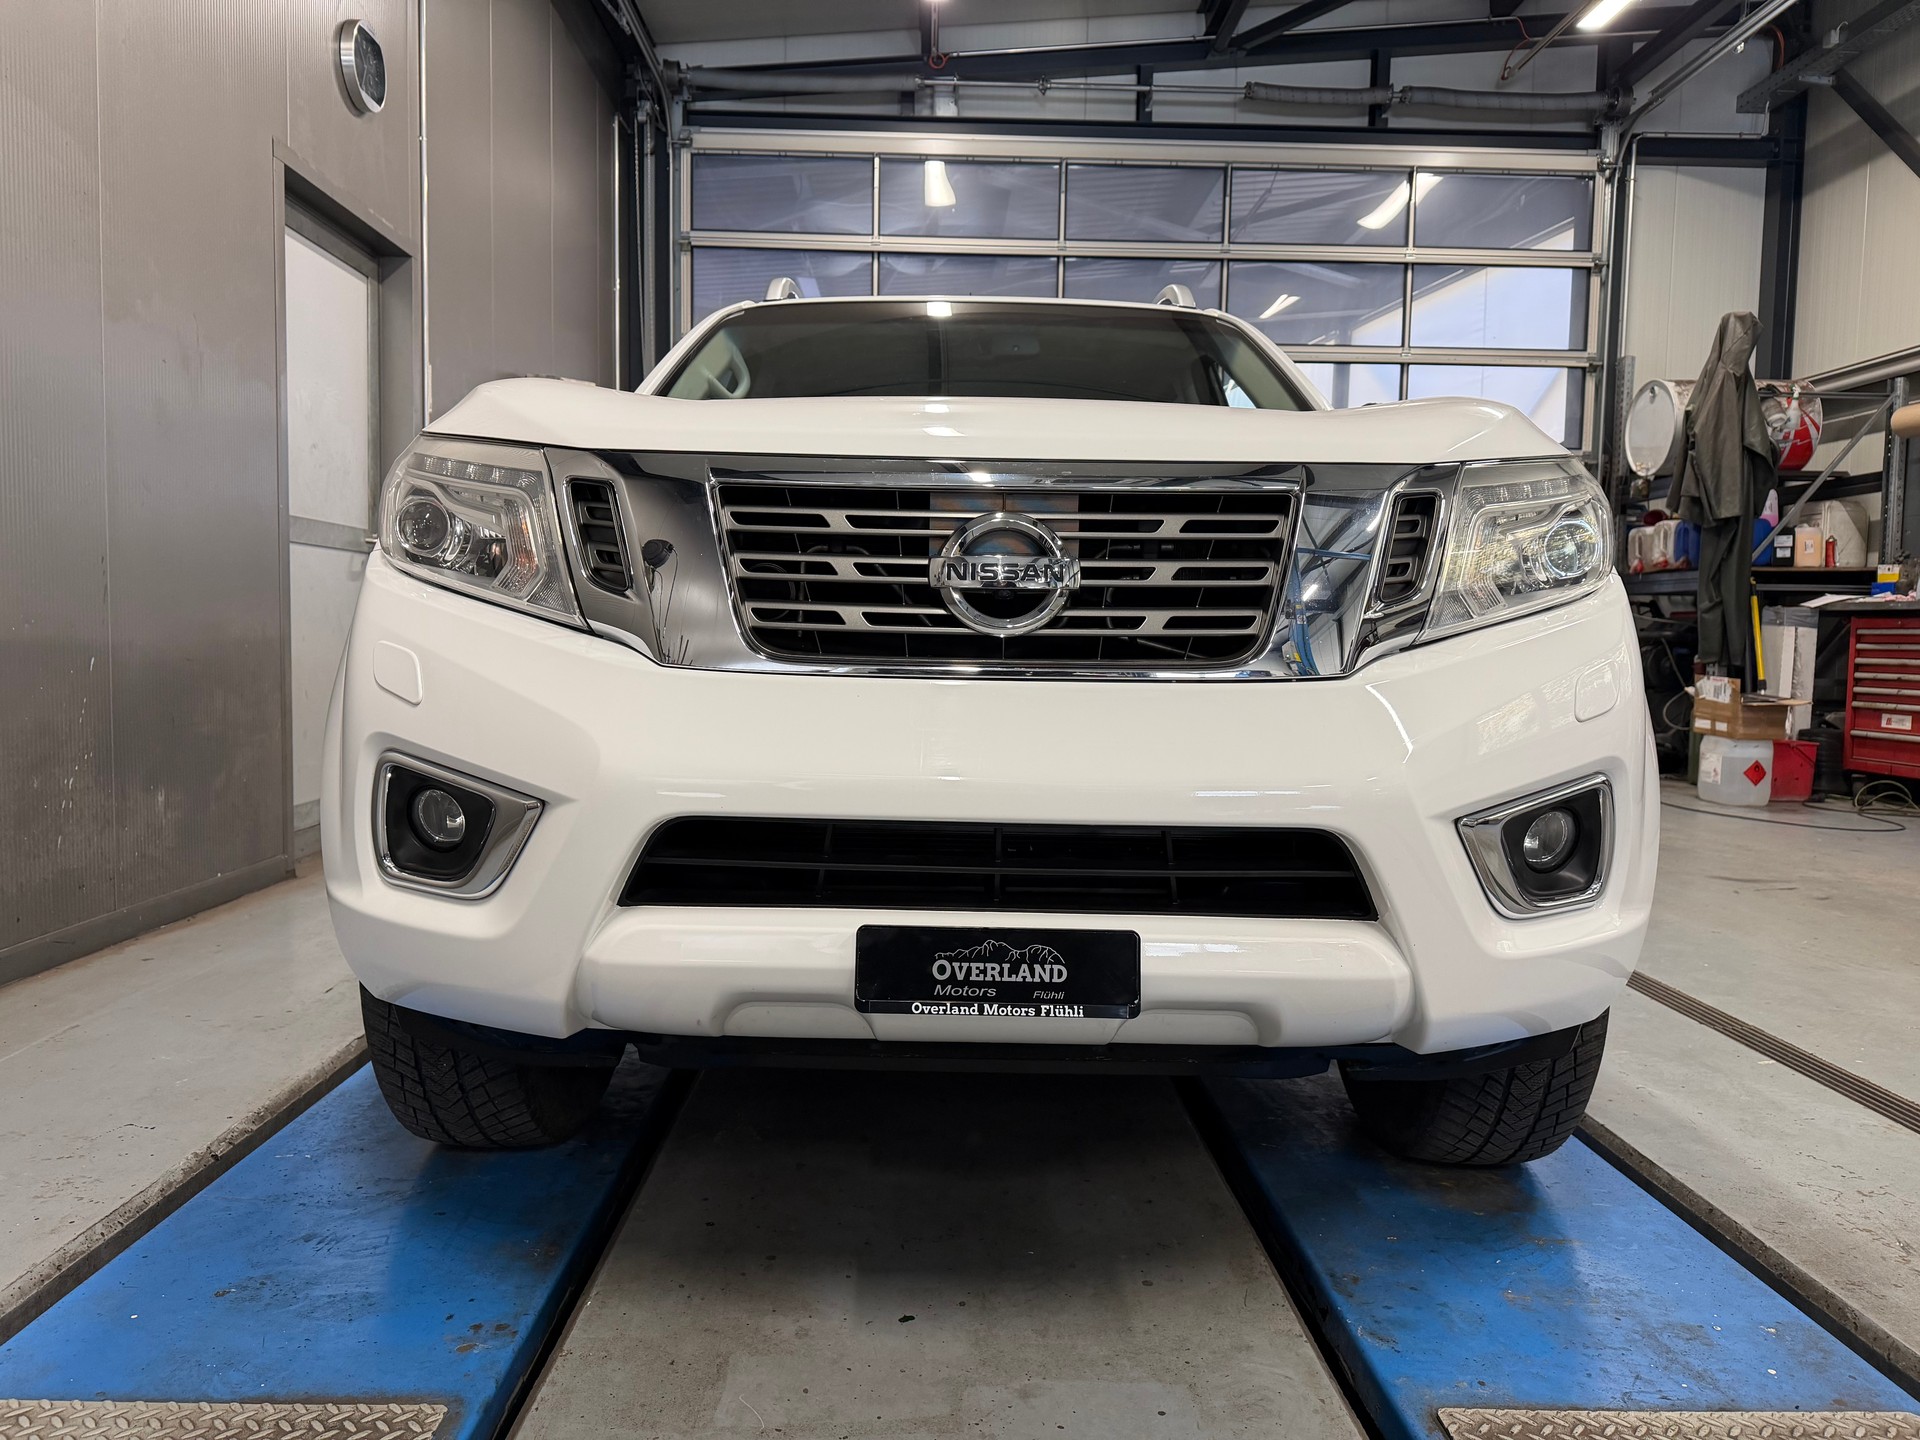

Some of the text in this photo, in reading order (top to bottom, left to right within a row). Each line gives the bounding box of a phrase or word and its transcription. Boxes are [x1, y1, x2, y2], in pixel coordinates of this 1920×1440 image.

[946, 561, 1065, 583] NISSAN
[932, 959, 1068, 983] OVERLAND
[934, 984, 997, 998] Motors
[1033, 990, 1065, 1000] Flühli
[911, 1002, 1084, 1018] Overland Motors Flühli
